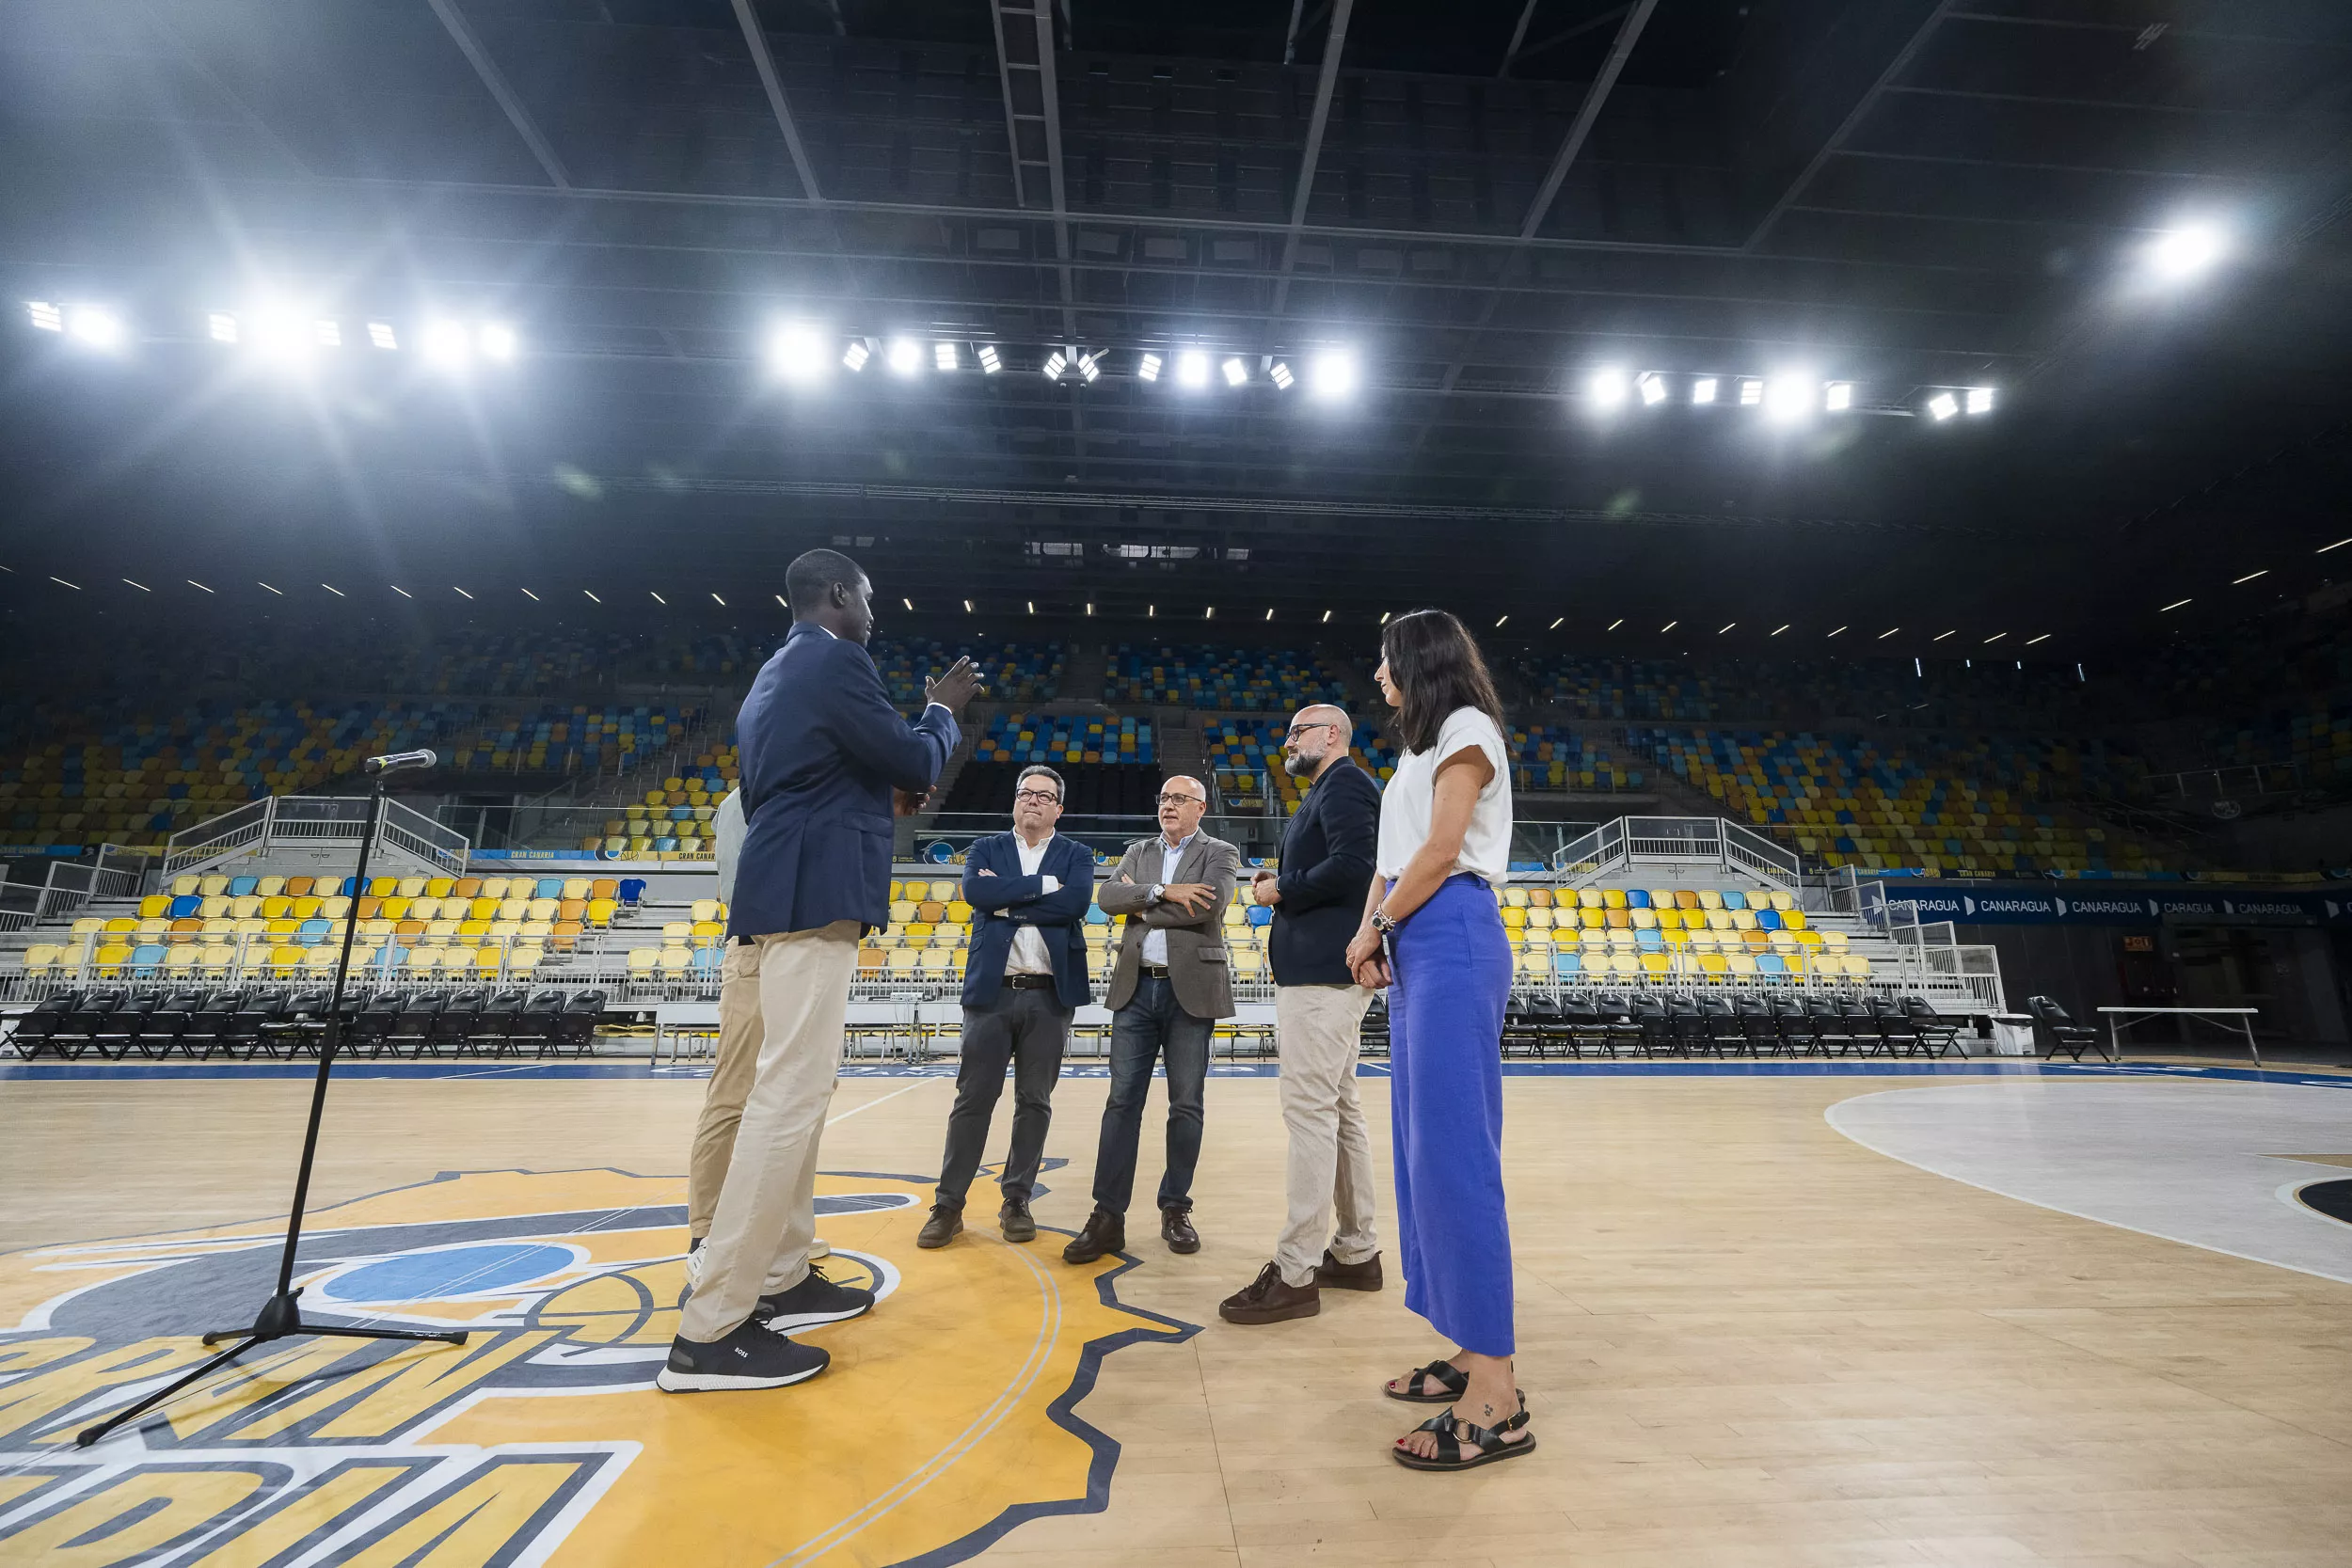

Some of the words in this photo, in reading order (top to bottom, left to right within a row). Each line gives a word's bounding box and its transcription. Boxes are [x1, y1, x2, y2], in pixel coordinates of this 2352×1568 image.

[511, 850, 528, 859] GRAN
[529, 850, 554, 859] CANARIA
[1888, 899, 1960, 911] CANARAGUA
[1980, 900, 2051, 912] CANARAGUA
[2072, 901, 2142, 913] CANARAGUA
[2164, 902, 2214, 913] CARAGUA
[2238, 903, 2303, 914] CANARAGUA
[734, 1347, 749, 1358] BOSS
